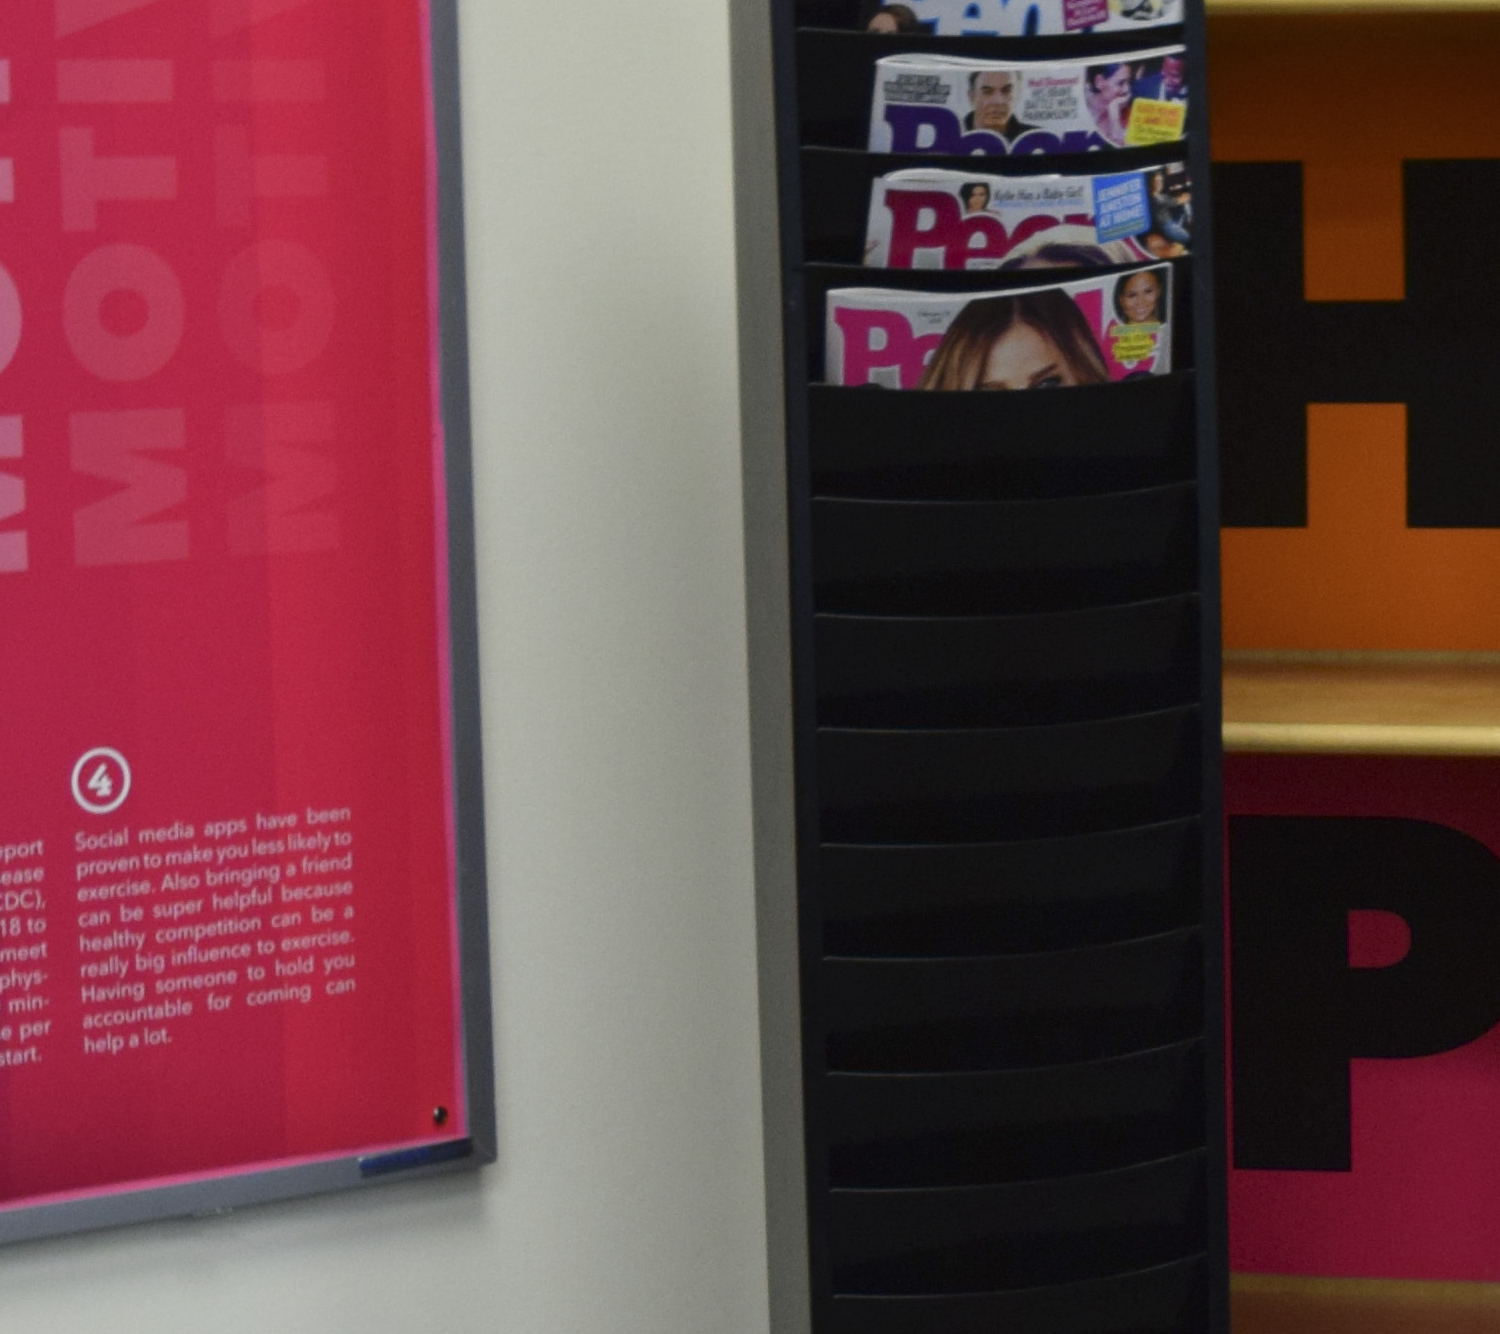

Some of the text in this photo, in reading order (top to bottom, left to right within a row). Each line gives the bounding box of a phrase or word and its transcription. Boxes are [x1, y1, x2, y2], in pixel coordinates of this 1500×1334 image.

[74, 806, 351, 852] Social media apps have been
[76, 830, 351, 881] proven to make you less likely to
[77, 851, 352, 902] exercise. Also bringing a friend
[0, 916, 21, 937] 18
[26, 917, 46, 934] to
[77, 880, 353, 928] can be super helpful because
